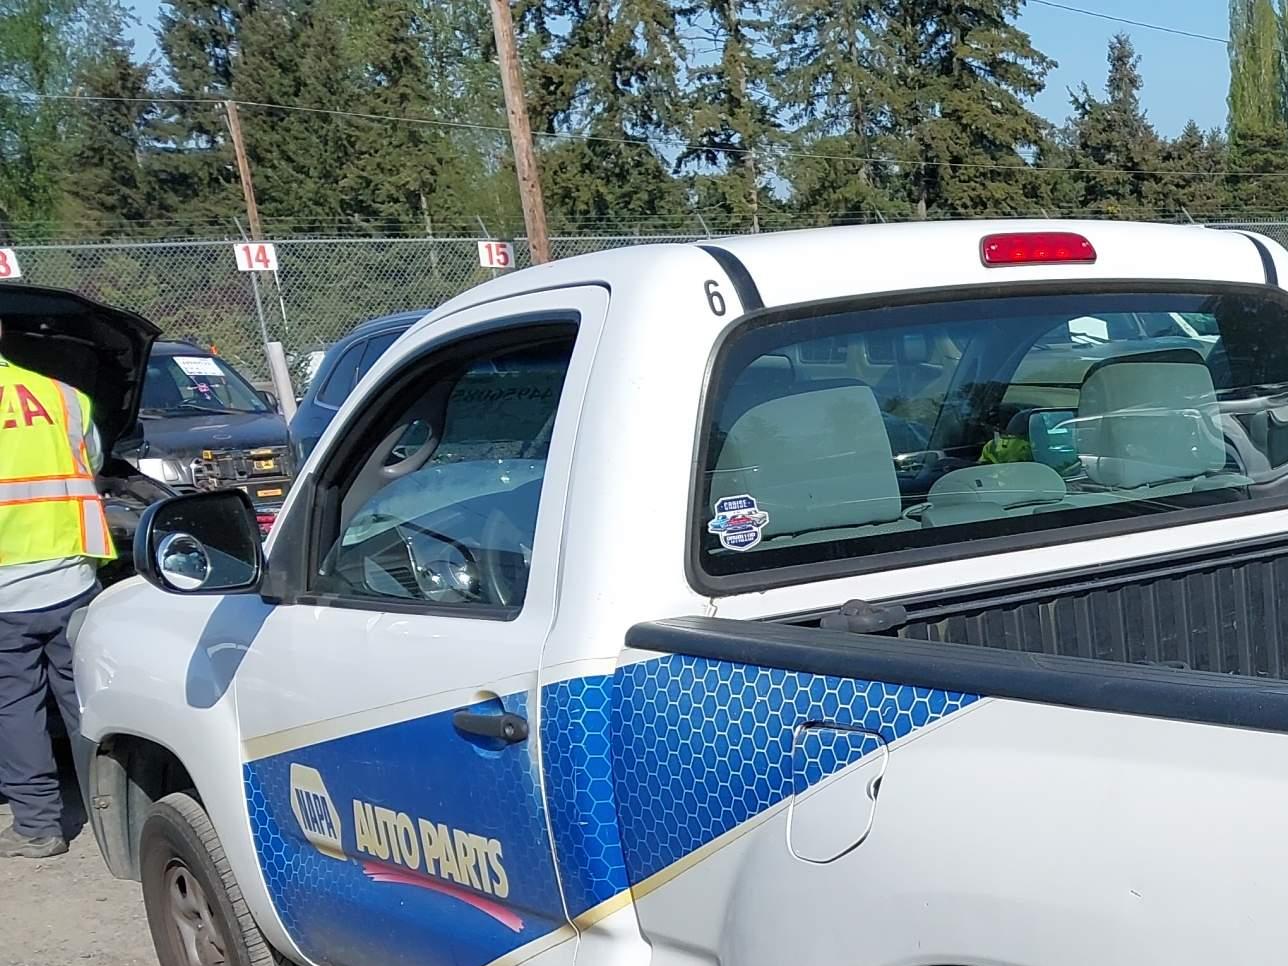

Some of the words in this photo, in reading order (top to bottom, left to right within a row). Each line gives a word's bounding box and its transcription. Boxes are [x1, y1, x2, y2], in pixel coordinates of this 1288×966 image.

[242, 245, 271, 270] 14
[486, 243, 511, 267] 15
[704, 279, 726, 316] 6
[294, 787, 339, 840] NAPA
[353, 798, 421, 871] AUTO
[418, 817, 509, 899] PARTS
